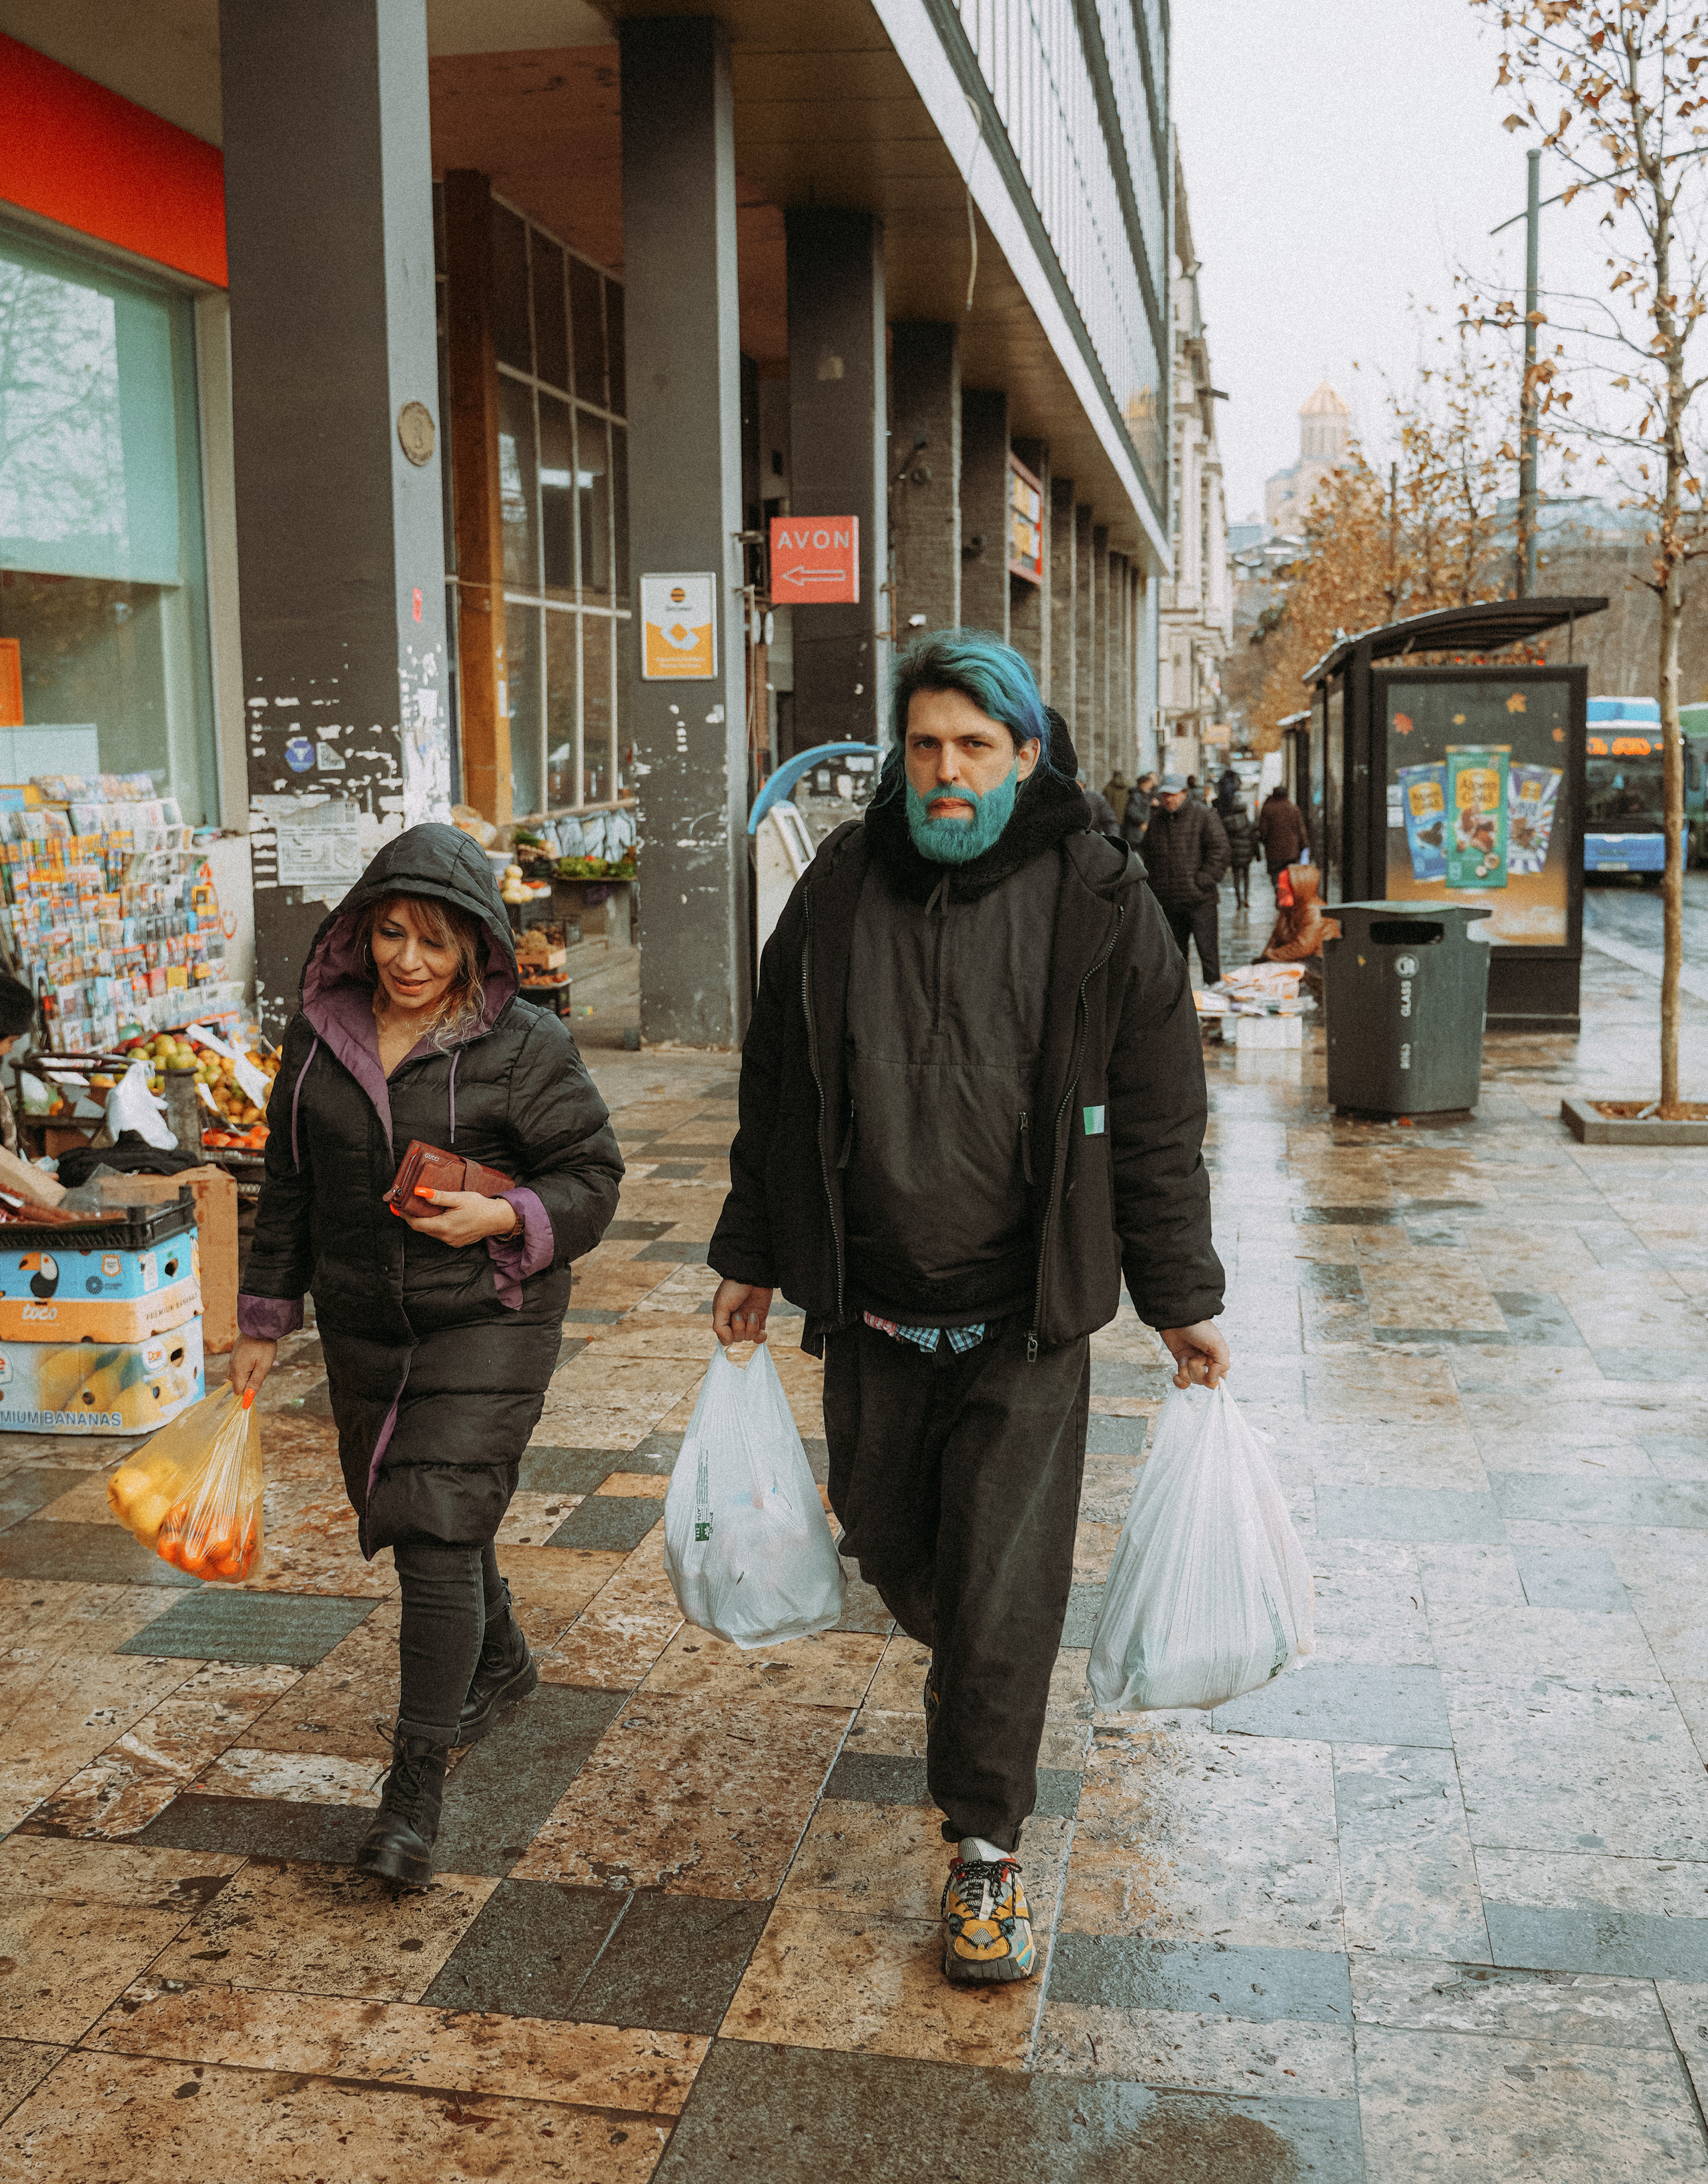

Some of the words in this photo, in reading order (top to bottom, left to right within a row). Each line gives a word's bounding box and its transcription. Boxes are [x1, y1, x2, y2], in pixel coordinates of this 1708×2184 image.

[777, 530, 849, 549] AVON
[1400, 980, 1411, 1017] GLASS
[424, 1153, 440, 1162] GUCCI
[22, 1304, 58, 1320] toco
[146, 1305, 174, 1321] PREMIUM
[44, 1411, 121, 1426] BANANAS
